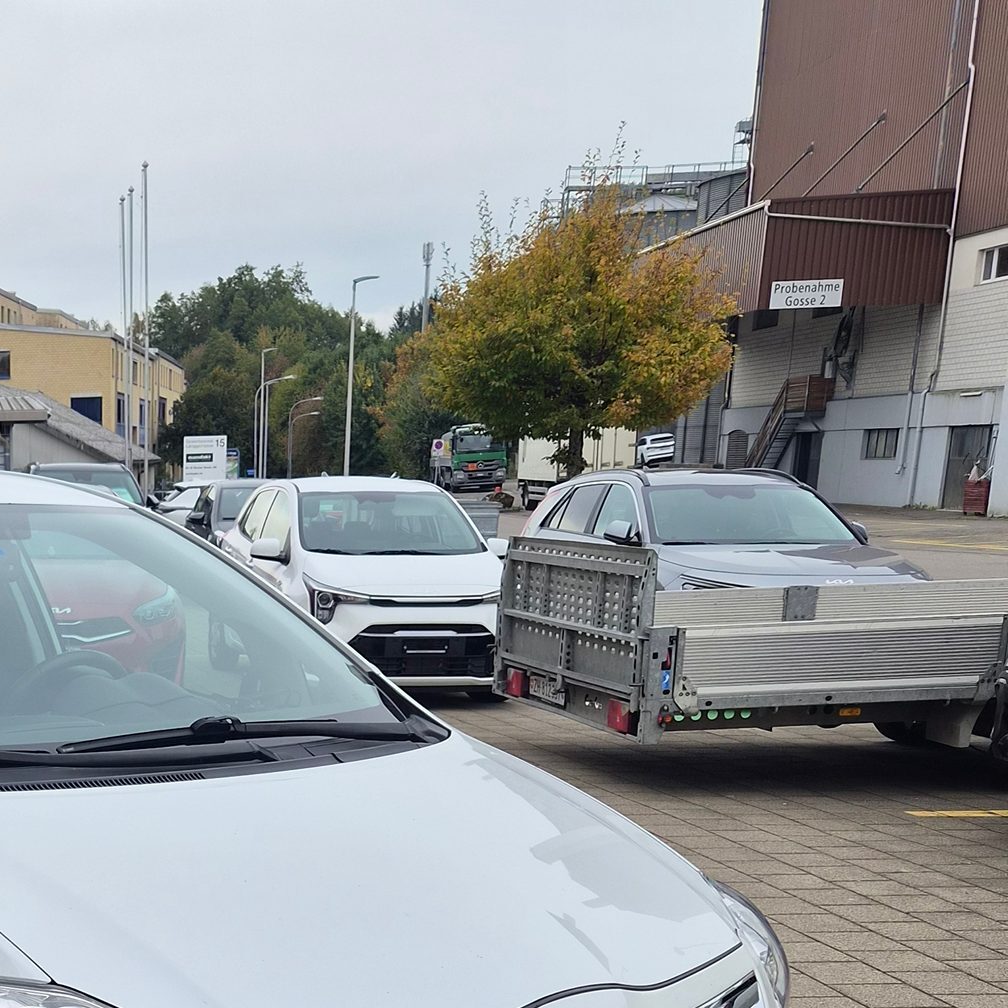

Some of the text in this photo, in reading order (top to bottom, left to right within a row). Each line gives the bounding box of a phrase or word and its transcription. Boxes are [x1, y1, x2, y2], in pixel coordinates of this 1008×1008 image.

[773, 281, 840, 294] Probenahme
[785, 294, 827, 308] Gosse 2
[215, 438, 225, 448] 15
